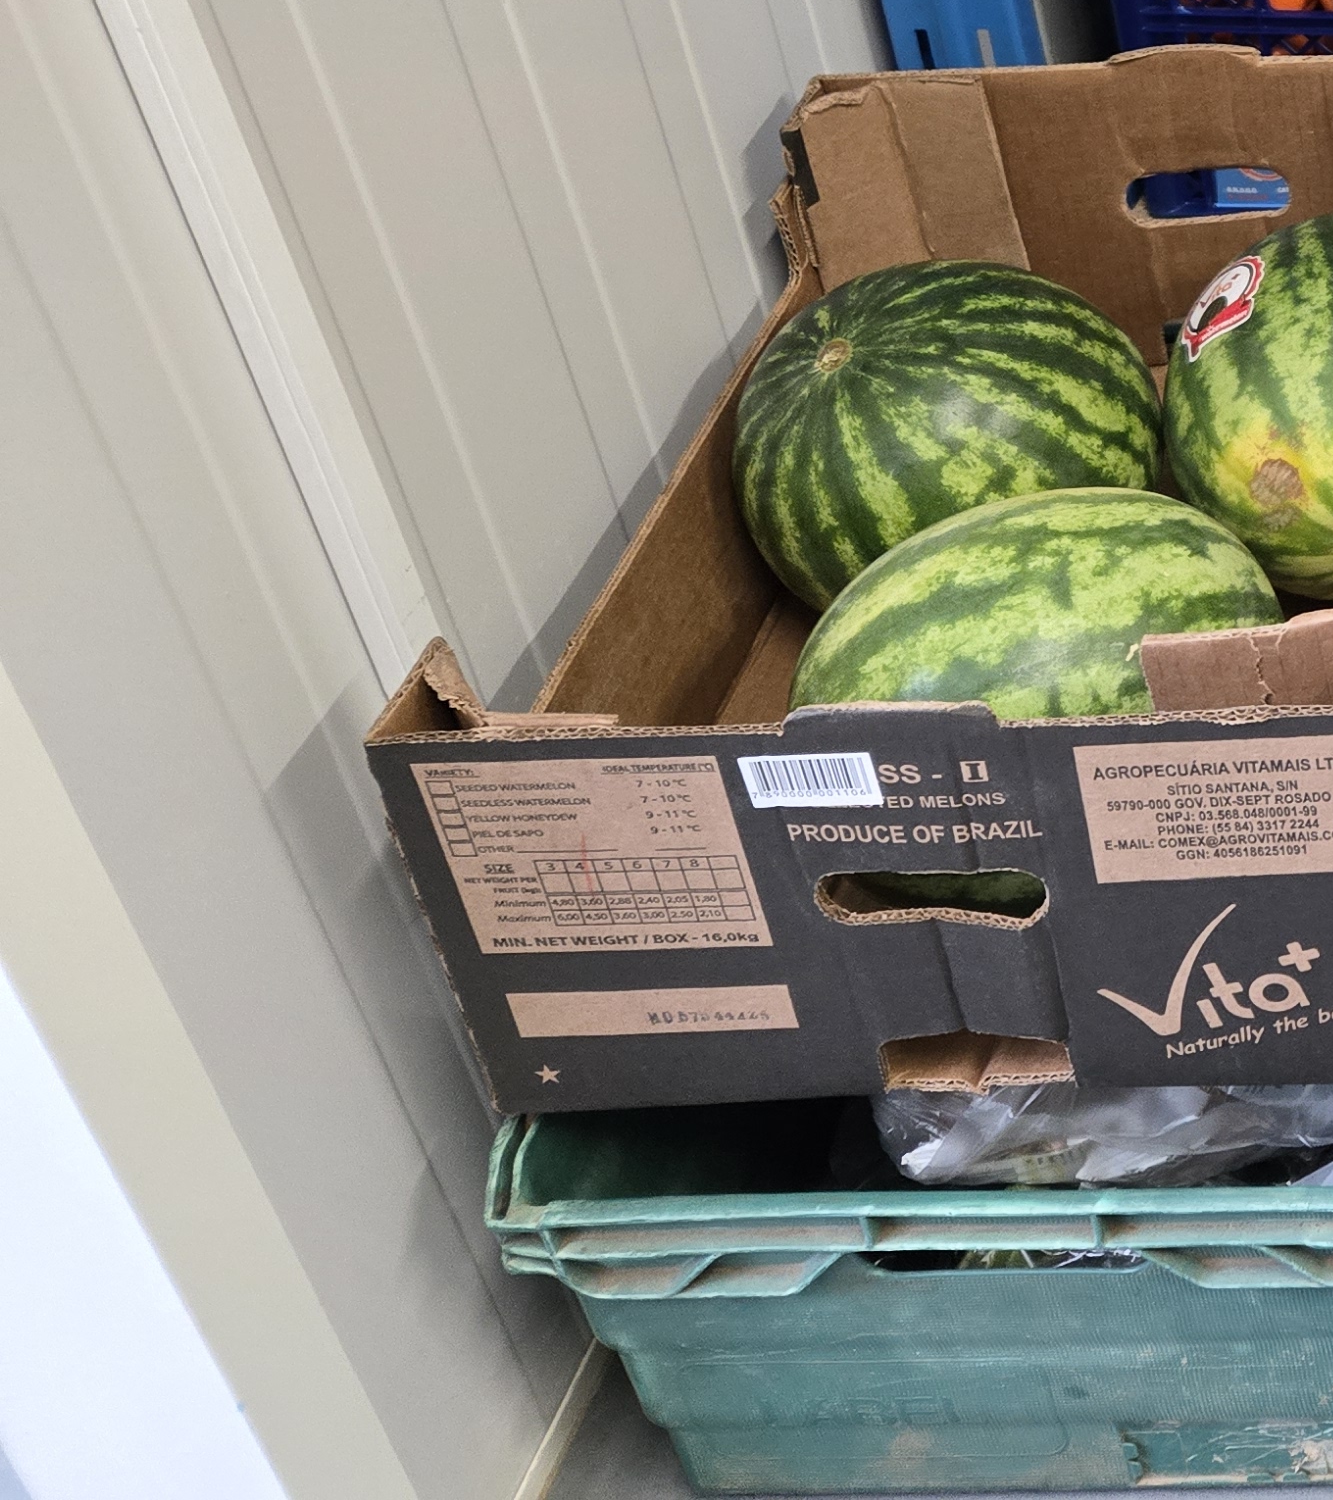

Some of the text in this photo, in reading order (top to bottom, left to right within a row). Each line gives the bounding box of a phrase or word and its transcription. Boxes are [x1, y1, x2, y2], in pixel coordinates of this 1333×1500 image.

[631, 763, 697, 773] TEMPERATURE
[1093, 759, 1231, 781] AGROPECUÁRIA
[1232, 757, 1312, 775] VITAMAIS
[454, 782, 576, 793] SEEDED WATERMELON
[752, 791, 758, 799] 7
[817, 788, 867, 798] 001106
[1166, 779, 1299, 796] SÍTIO SANTANA, S/N
[460, 798, 592, 808] SEEDLESS WATERMELON
[919, 792, 1007, 809] MELONS
[1106, 799, 1172, 812] 59790-000
[1174, 797, 1208, 810] GOV.
[1210, 794, 1271, 808] DIX-SEPT
[1274, 792, 1332, 805] ROSADO
[466, 813, 579, 823] YELLOW HONEYDEW
[1155, 806, 1318, 823] CNPJ: 03.568.048/0001-99
[472, 829, 544, 838] PIEL DE SAPO
[786, 819, 1044, 844] PRODUCE OF BRAZIL
[1157, 817, 1320, 836] PHONE: (55 84) 3317 2244
[477, 845, 514, 854] OTHER
[1104, 838, 1155, 851] E-MAIL:
[1176, 844, 1308, 861] GGN: 4056186251091
[484, 858, 700, 874] SIZE 3 4 5 6 7 8
[483, 876, 519, 884] WEIGHT
[520, 876, 538, 884] PER
[494, 900, 547, 908] Minimum
[497, 914, 551, 923] Maximum
[493, 931, 760, 948] MIN. NET WEIGHT BOX 16,0kg
[1166, 1025, 1265, 1059] Naturally
[1273, 1015, 1309, 1035] the
